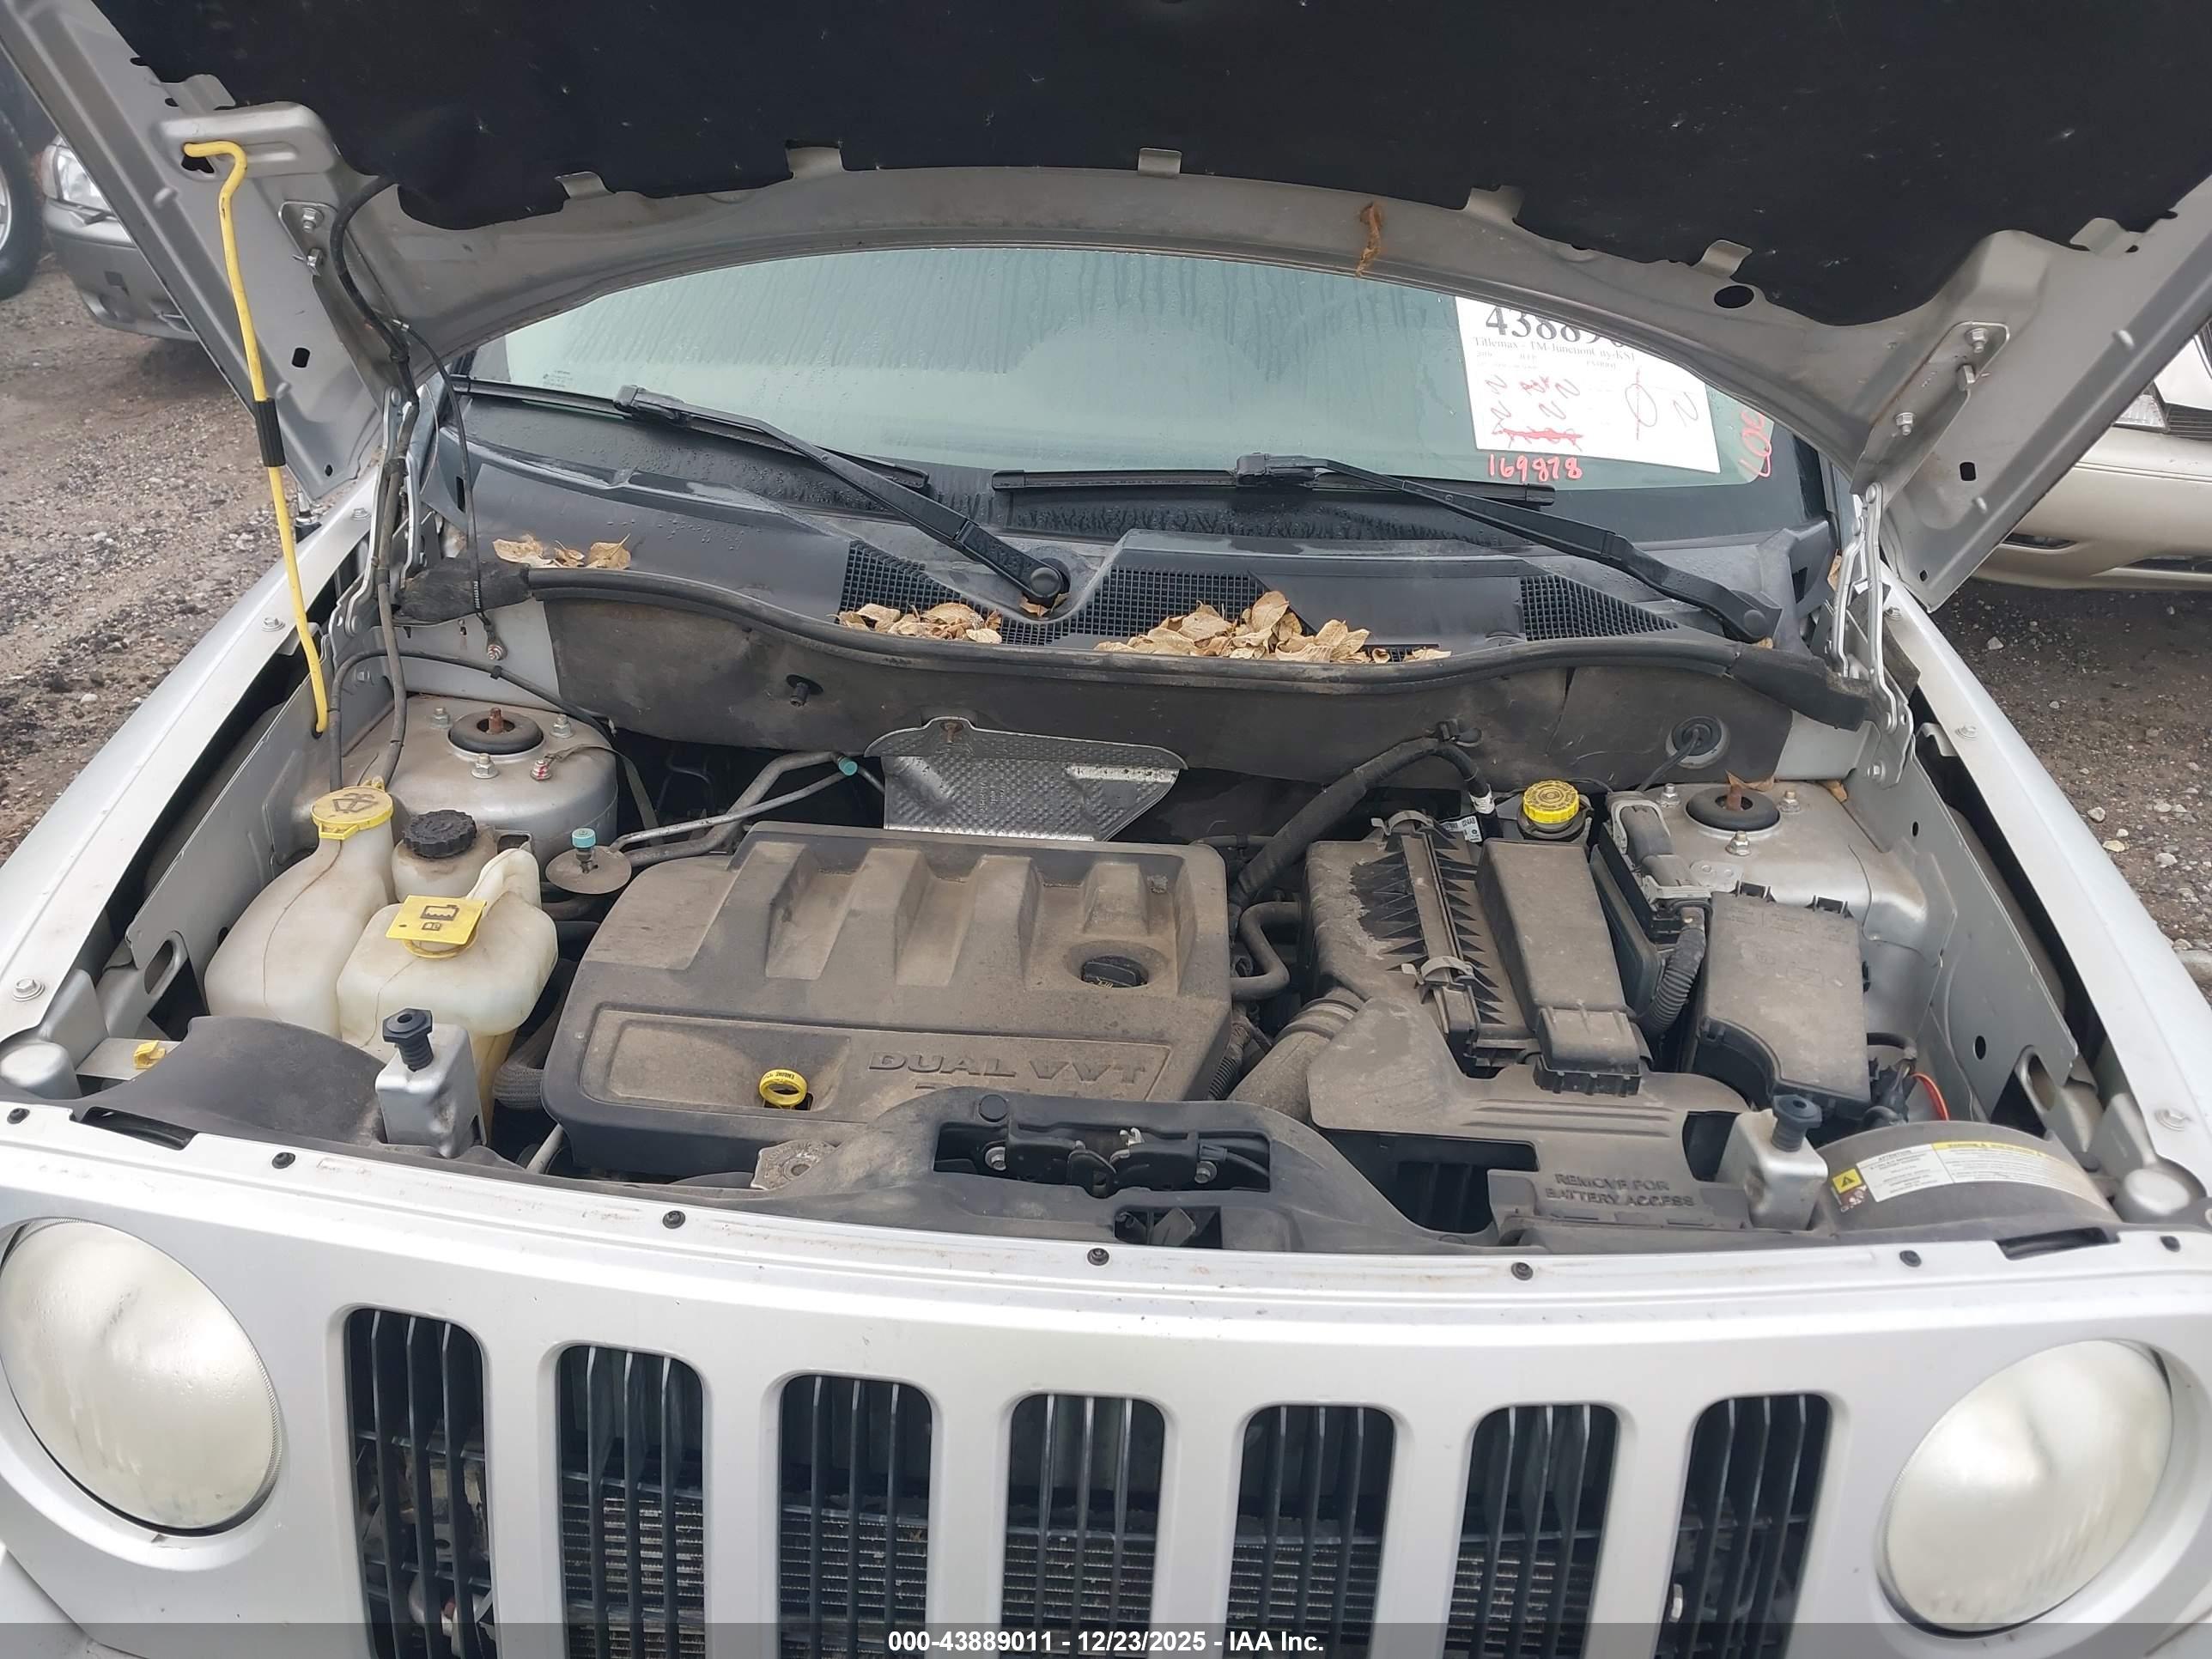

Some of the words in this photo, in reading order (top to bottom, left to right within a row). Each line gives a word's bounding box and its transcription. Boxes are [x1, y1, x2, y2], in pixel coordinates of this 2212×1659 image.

[1489, 453, 1583, 482] 169878
[867, 1051, 1017, 1079] DUAL
[1029, 1060, 1146, 1085] VVT
[1554, 1173, 1629, 1191] REMOVE
[1631, 1179, 1670, 1192] FOR
[1545, 1187, 1620, 1206] BATTERY
[1627, 1194, 1698, 1207] ACCESS
